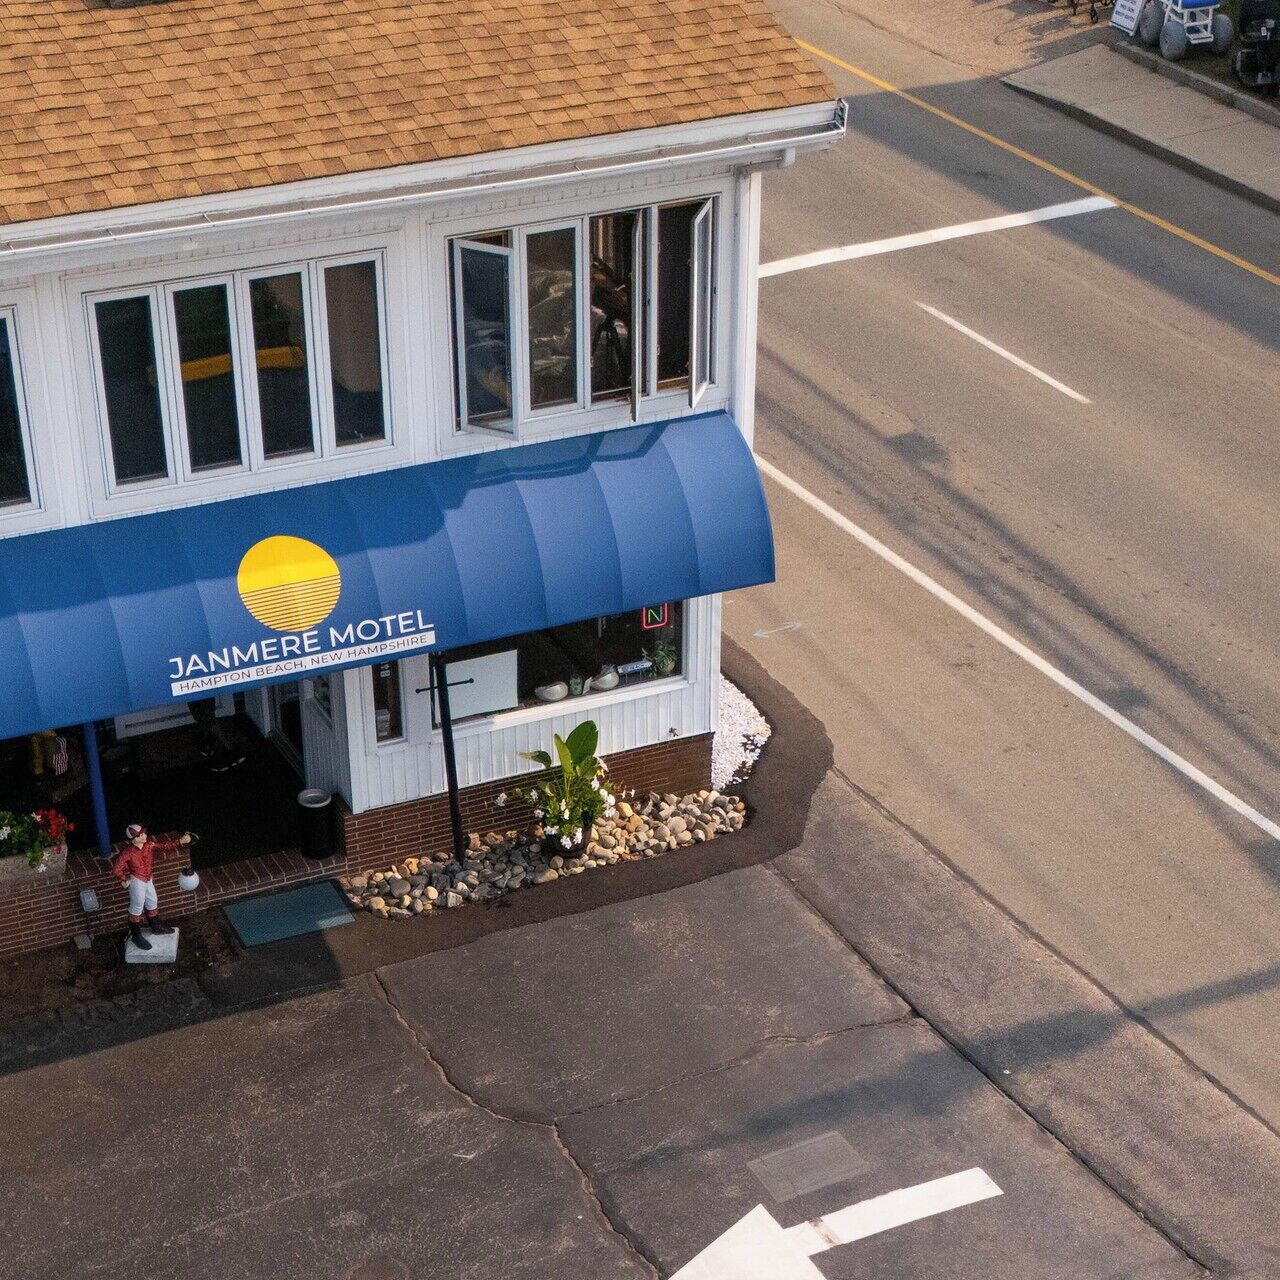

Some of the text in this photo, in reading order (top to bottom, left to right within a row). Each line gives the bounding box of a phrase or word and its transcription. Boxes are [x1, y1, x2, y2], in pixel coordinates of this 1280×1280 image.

[169, 610, 435, 679] JANMERE MOTEL
[180, 634, 427, 692] HAMPTON BEACH, NEW HAMPSHIRE
